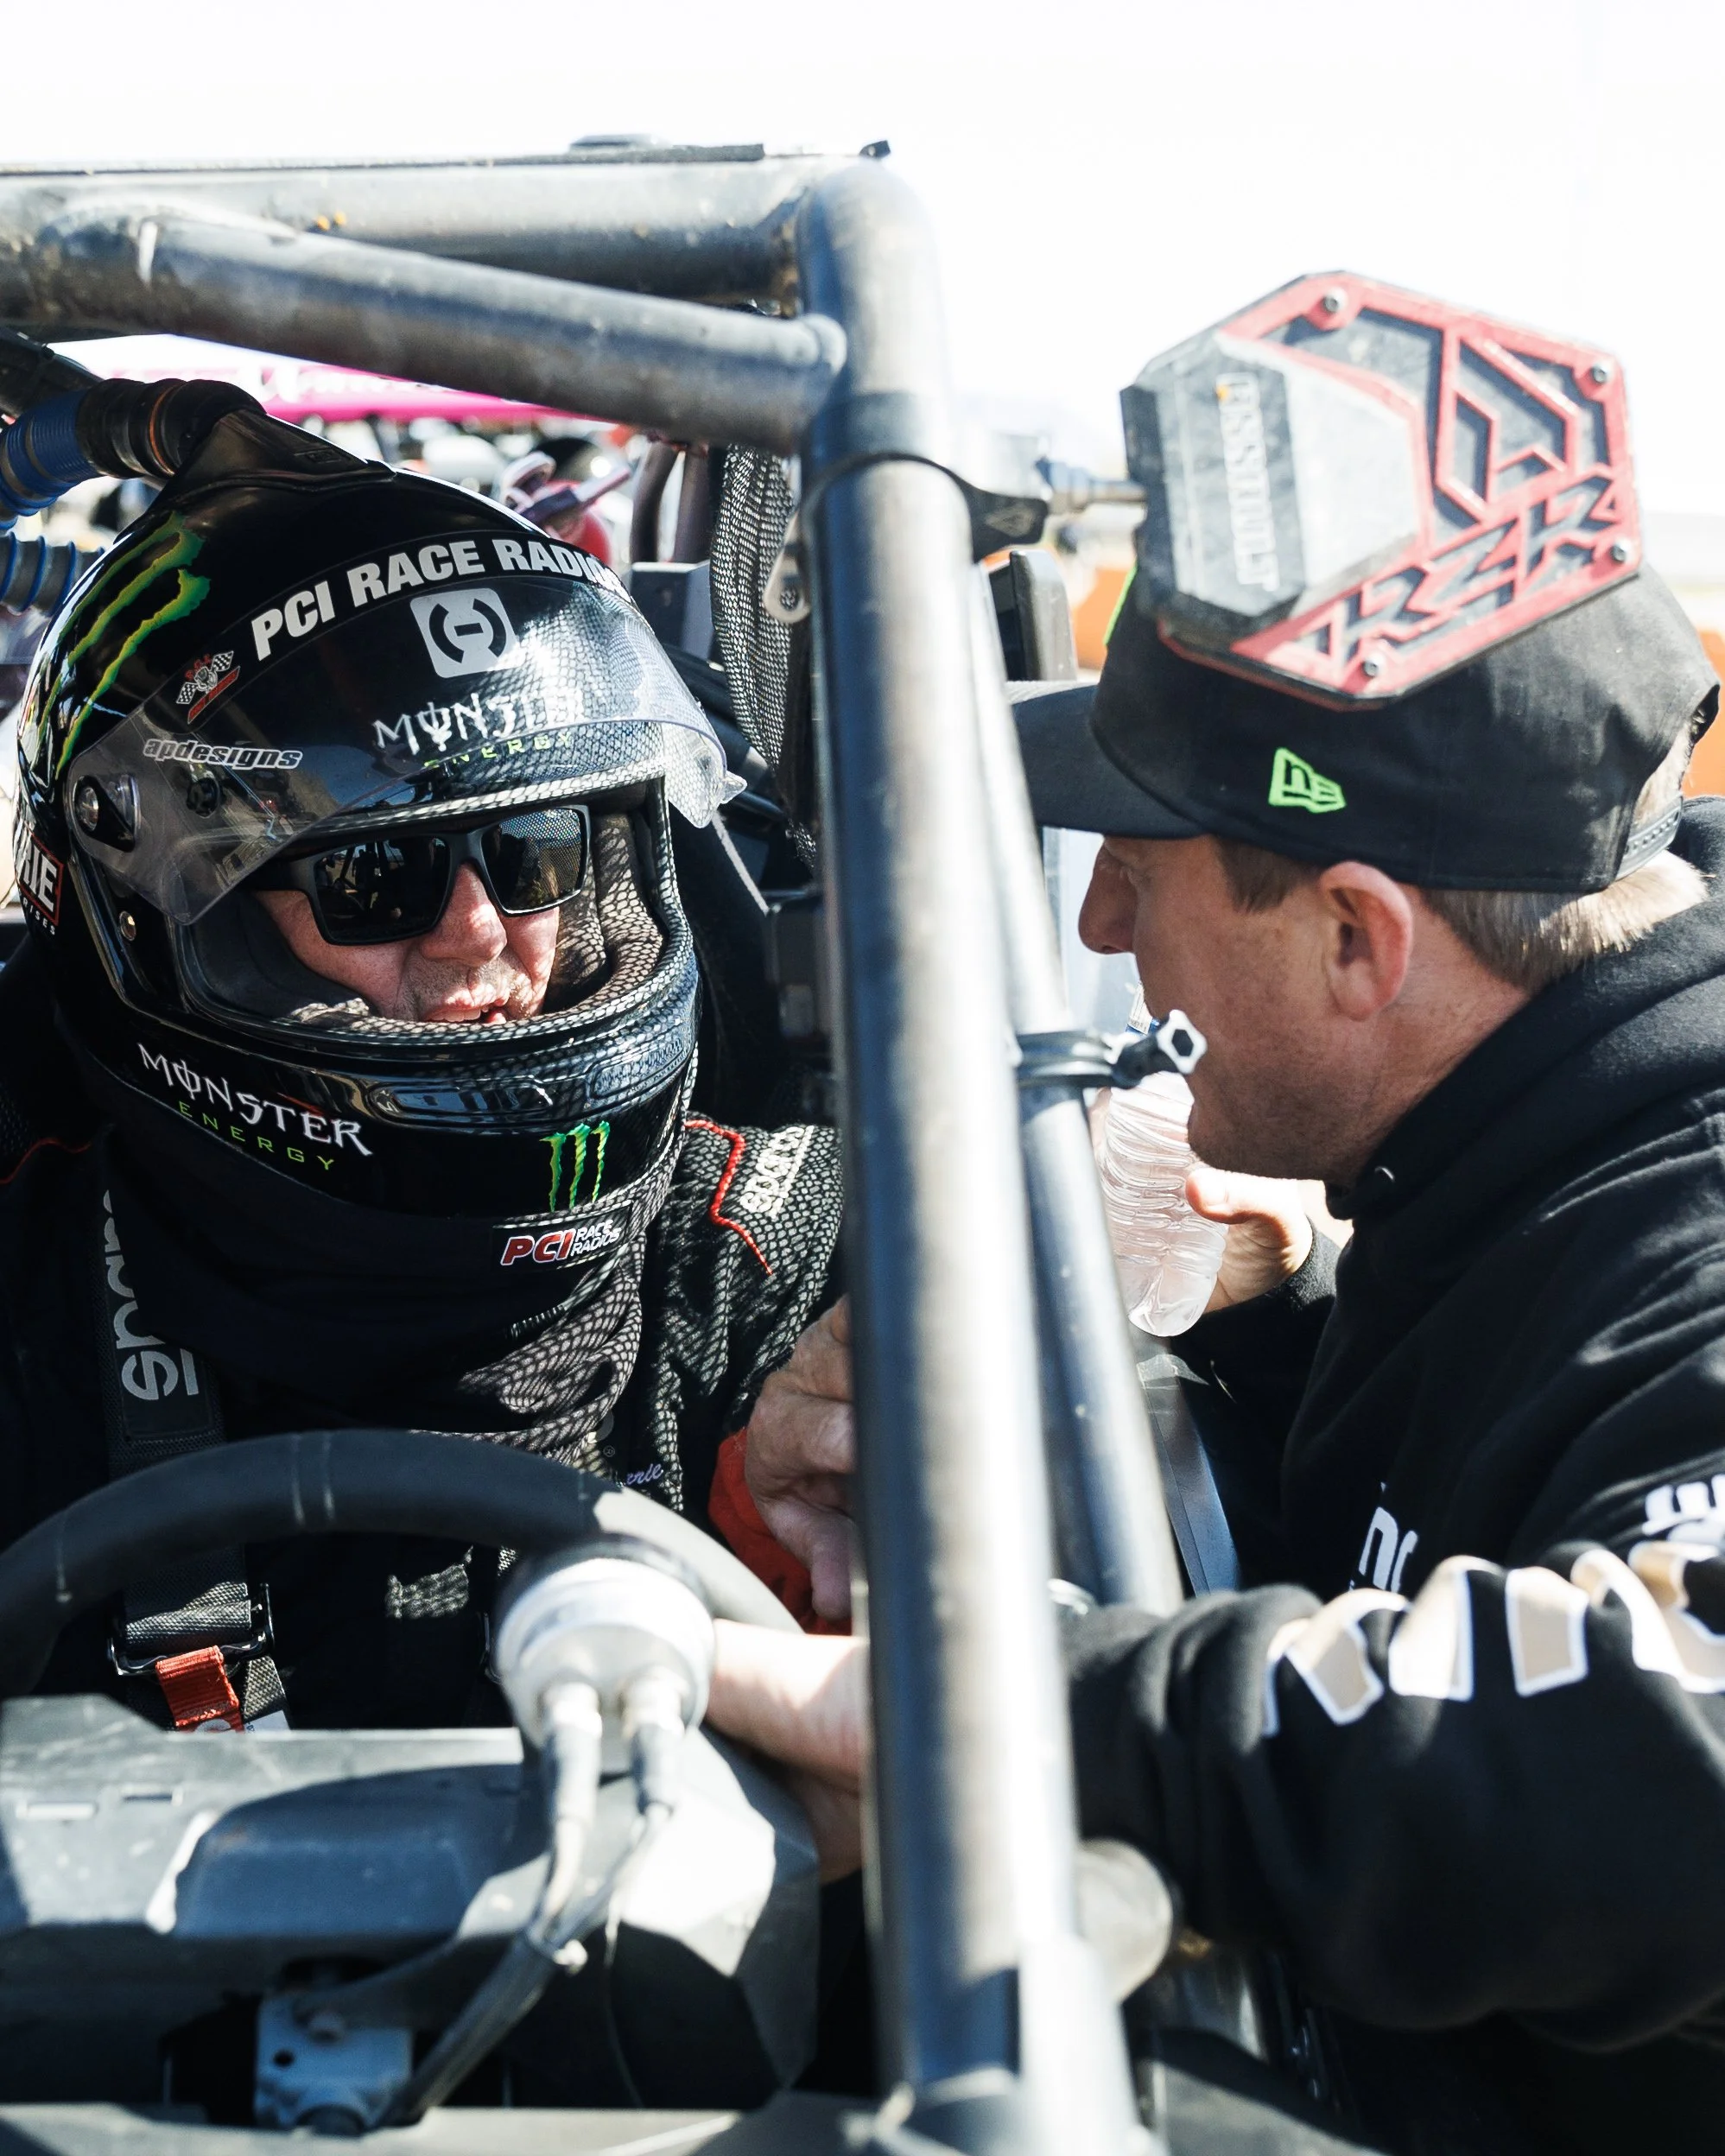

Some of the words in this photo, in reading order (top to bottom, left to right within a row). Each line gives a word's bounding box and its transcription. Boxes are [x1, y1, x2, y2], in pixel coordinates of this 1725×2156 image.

[251, 580, 335, 661] PCI
[346, 539, 485, 607] RACE
[137, 1043, 373, 1156] MONSTER
[179, 1100, 334, 1170] ENERGY
[500, 1228, 576, 1266] PCI
[570, 1227, 622, 1256] RADIOS
[574, 1219, 614, 1243] RACE
